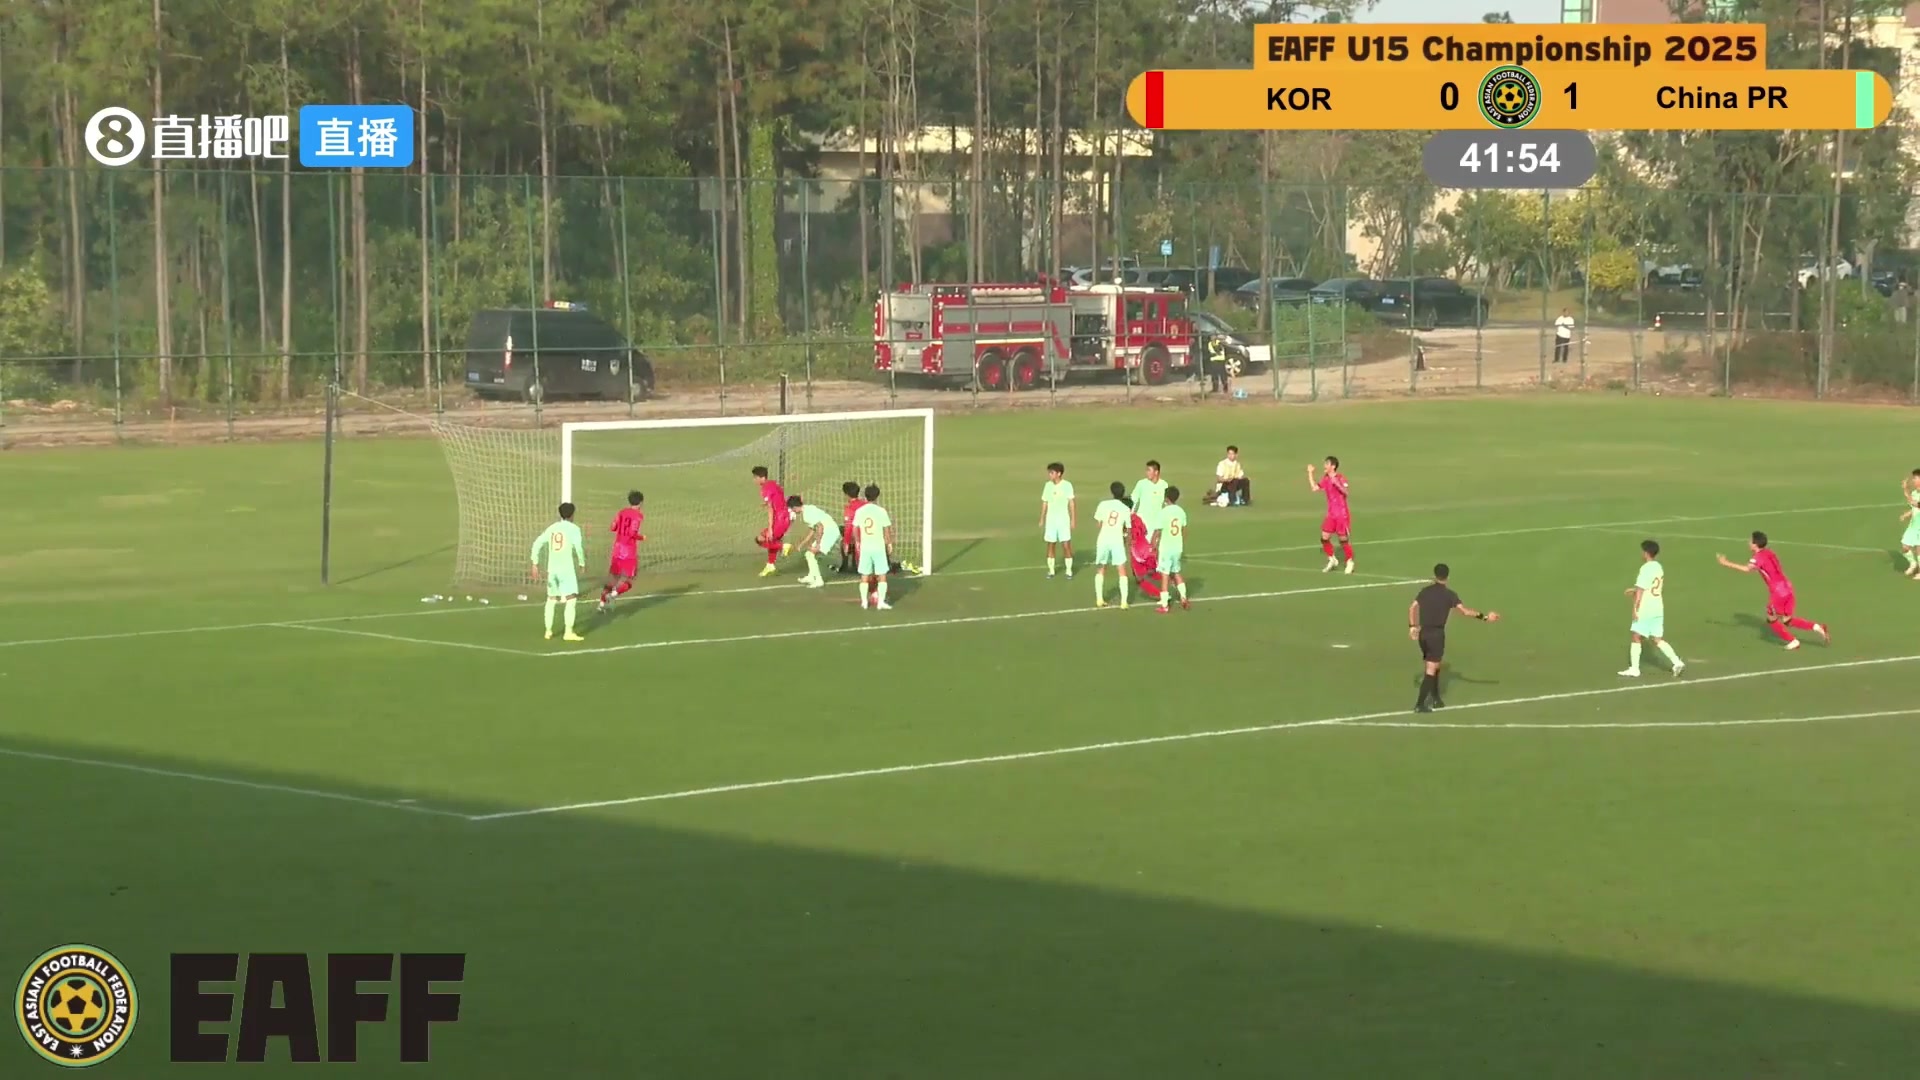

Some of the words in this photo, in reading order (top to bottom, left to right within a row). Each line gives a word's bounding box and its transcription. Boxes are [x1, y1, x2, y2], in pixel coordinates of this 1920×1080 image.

[863, 517, 876, 536] 2
[1108, 510, 1119, 527] 8
[1170, 518, 1179, 537] 5
[550, 532, 564, 552] 19
